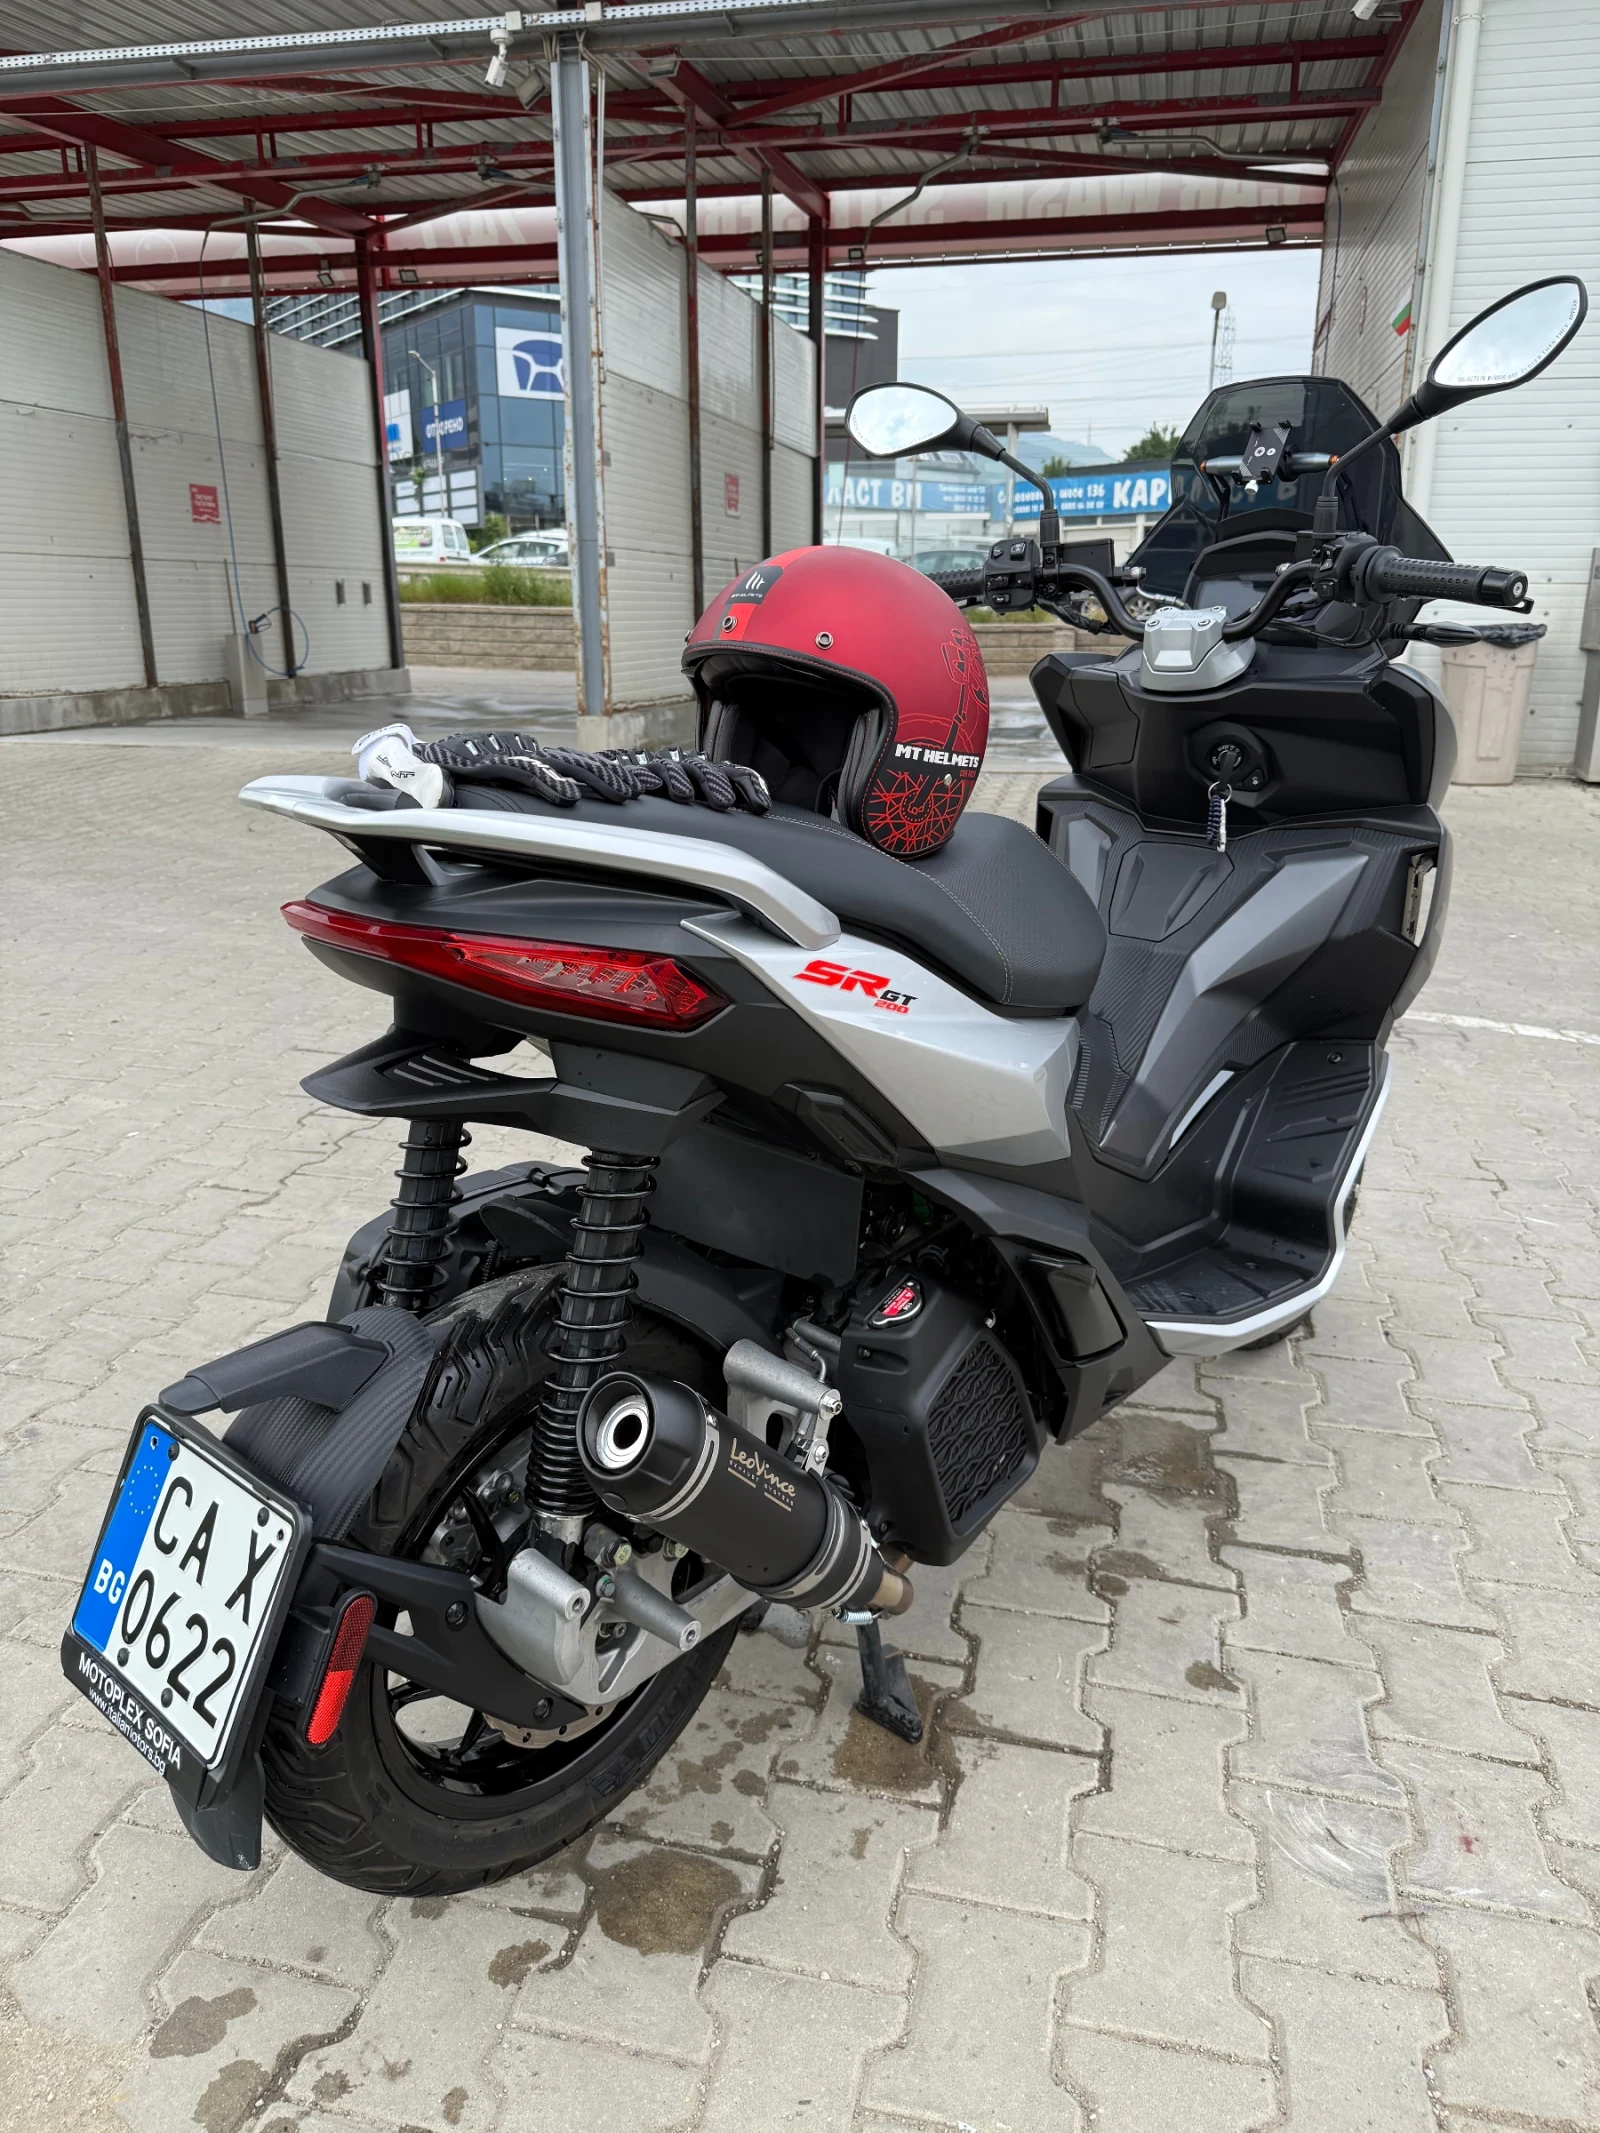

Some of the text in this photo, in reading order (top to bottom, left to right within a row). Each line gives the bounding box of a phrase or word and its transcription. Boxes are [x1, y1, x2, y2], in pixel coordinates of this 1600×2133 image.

[1086, 484, 1105, 498] 136
[895, 744, 979, 768] MT HELMETS
[792, 959, 919, 1006] SR GT
[873, 999, 910, 1015] 200
[730, 1437, 796, 1497] LeoVince
[154, 1476, 220, 1586] CA
[93, 1558, 126, 1605] BG
[121, 1569, 236, 1729] 0622
[78, 1652, 182, 1771] MOTOPLEX SOFIA
